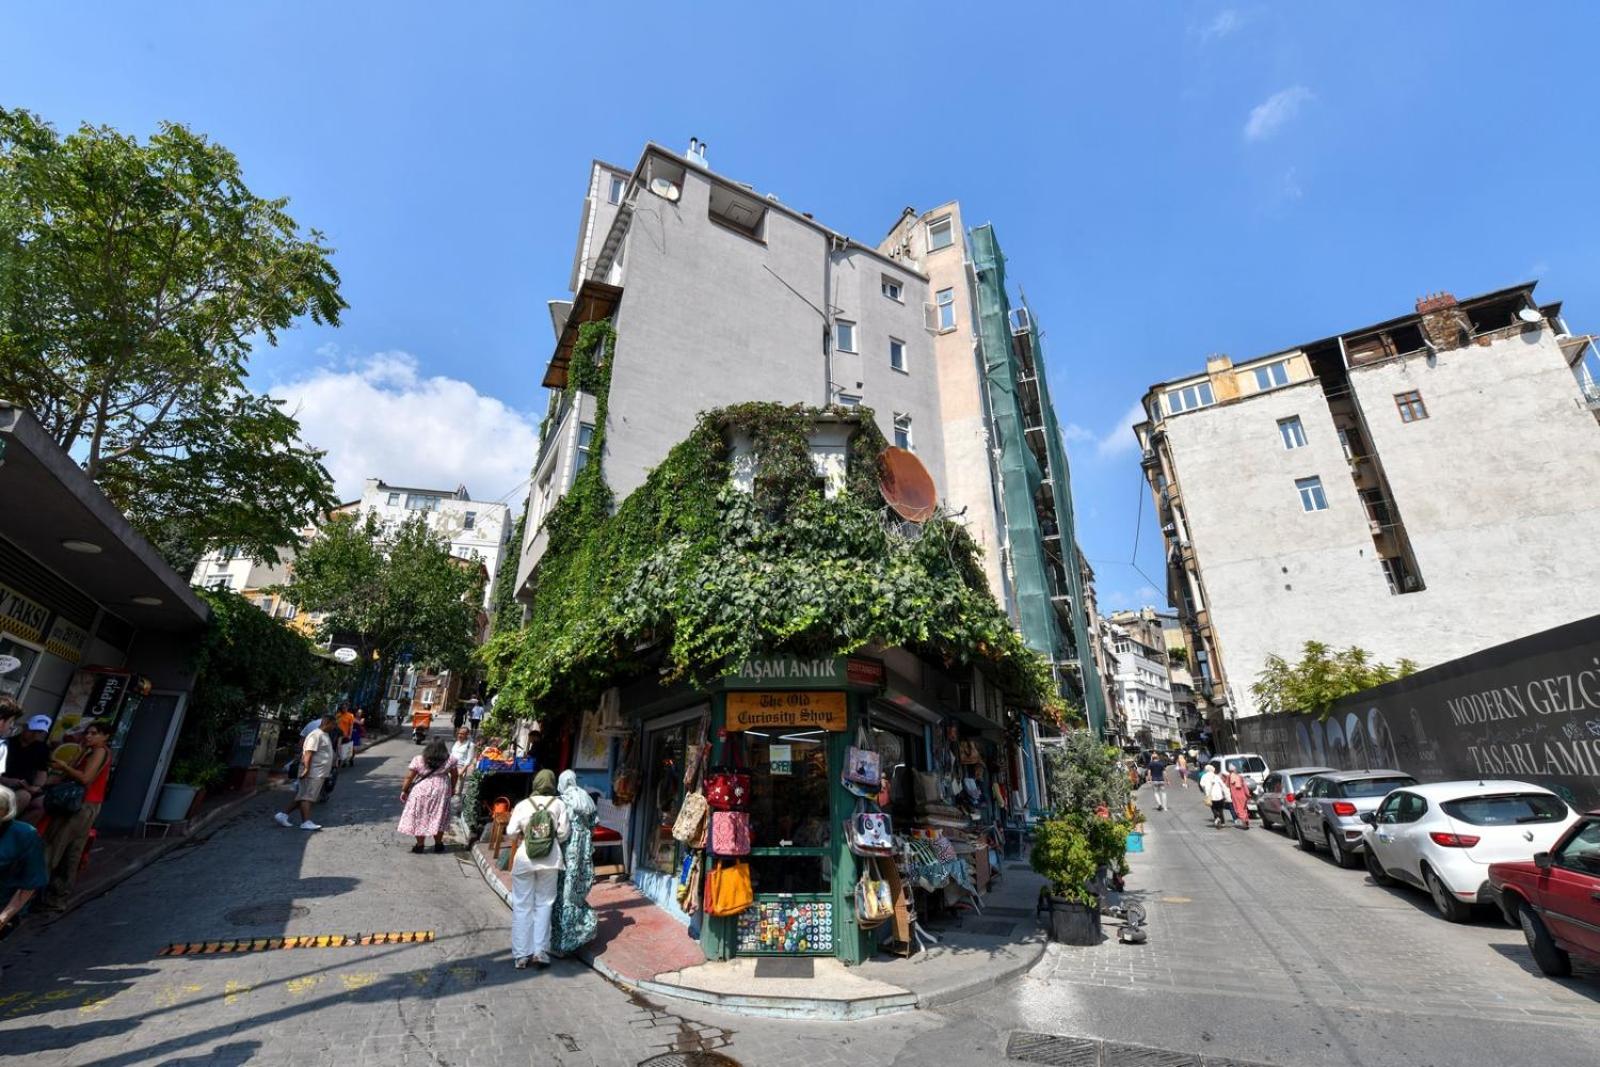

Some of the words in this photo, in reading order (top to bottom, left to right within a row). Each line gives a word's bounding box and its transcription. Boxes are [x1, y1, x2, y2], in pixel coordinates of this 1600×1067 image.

[92, 678, 121, 715] Cappy
[759, 694, 782, 709] The
[787, 694, 810, 707] Old
[1447, 685, 1528, 727] MODERN
[1527, 657, 1600, 716] GEZG
[737, 709, 796, 724] Curiosity
[799, 708, 834, 724] Shop
